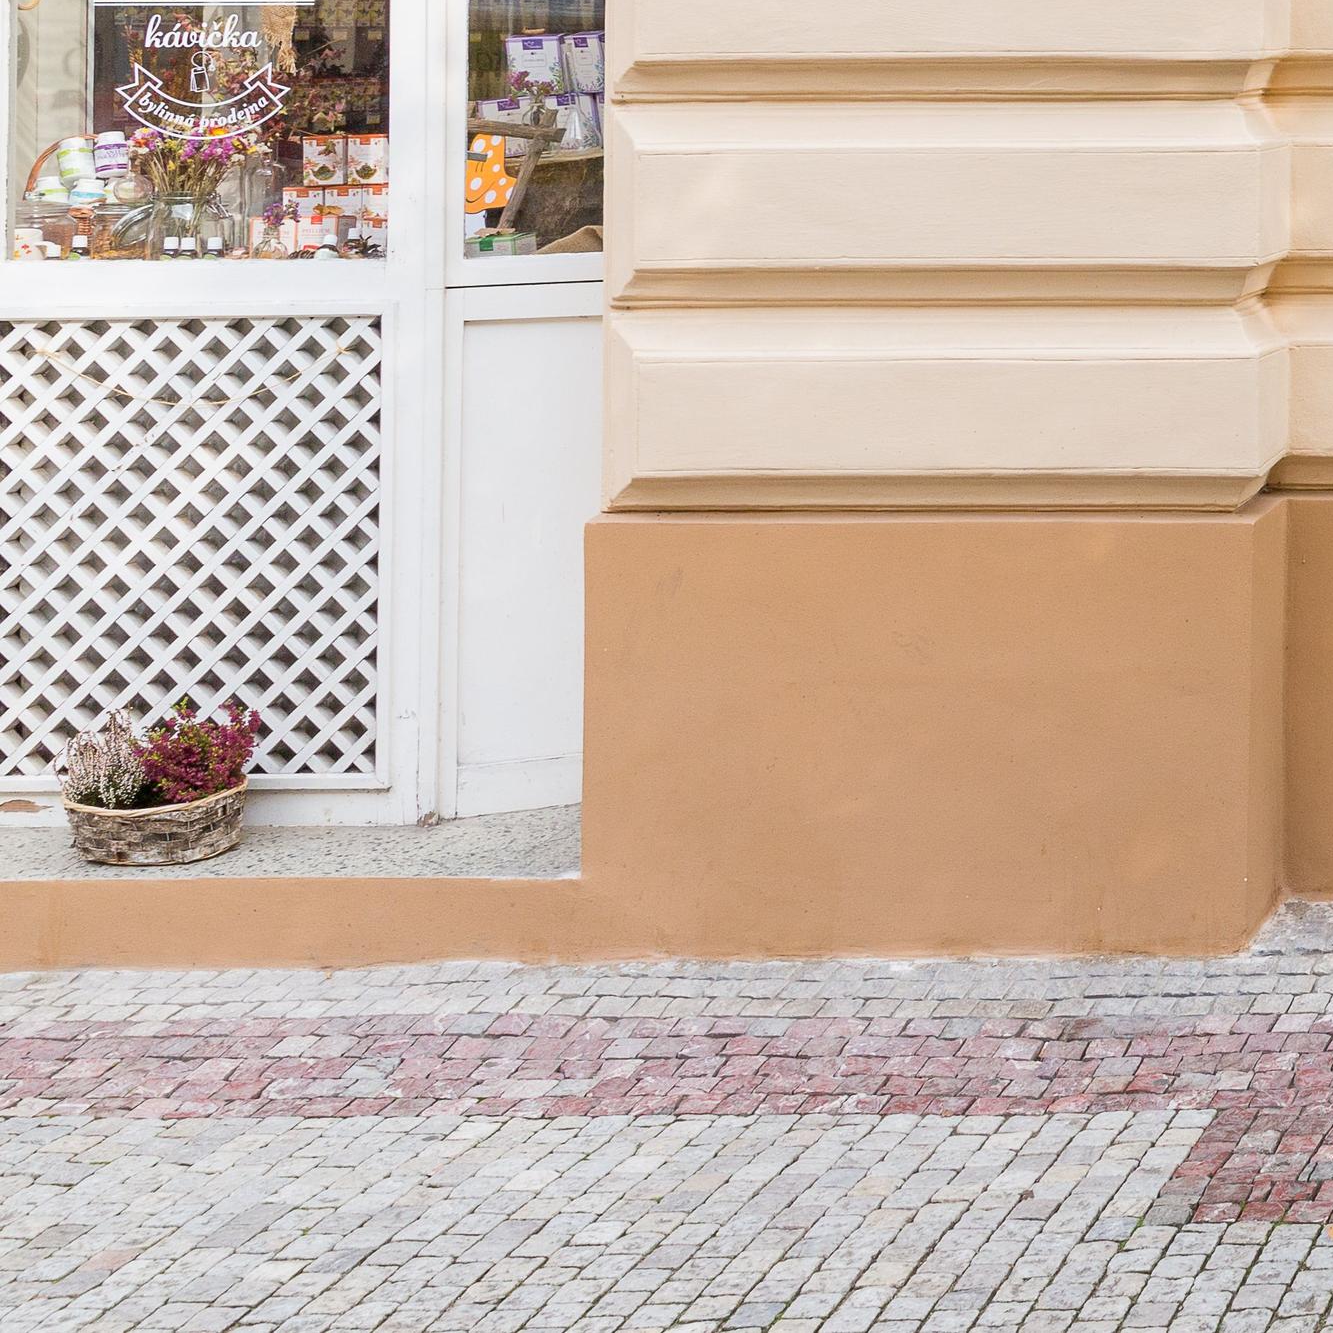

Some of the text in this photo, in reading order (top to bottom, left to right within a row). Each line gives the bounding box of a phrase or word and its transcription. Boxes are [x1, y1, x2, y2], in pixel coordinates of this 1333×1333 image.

[144, 14, 262, 48] kávička
[138, 93, 270, 132] bylinná prodejna
